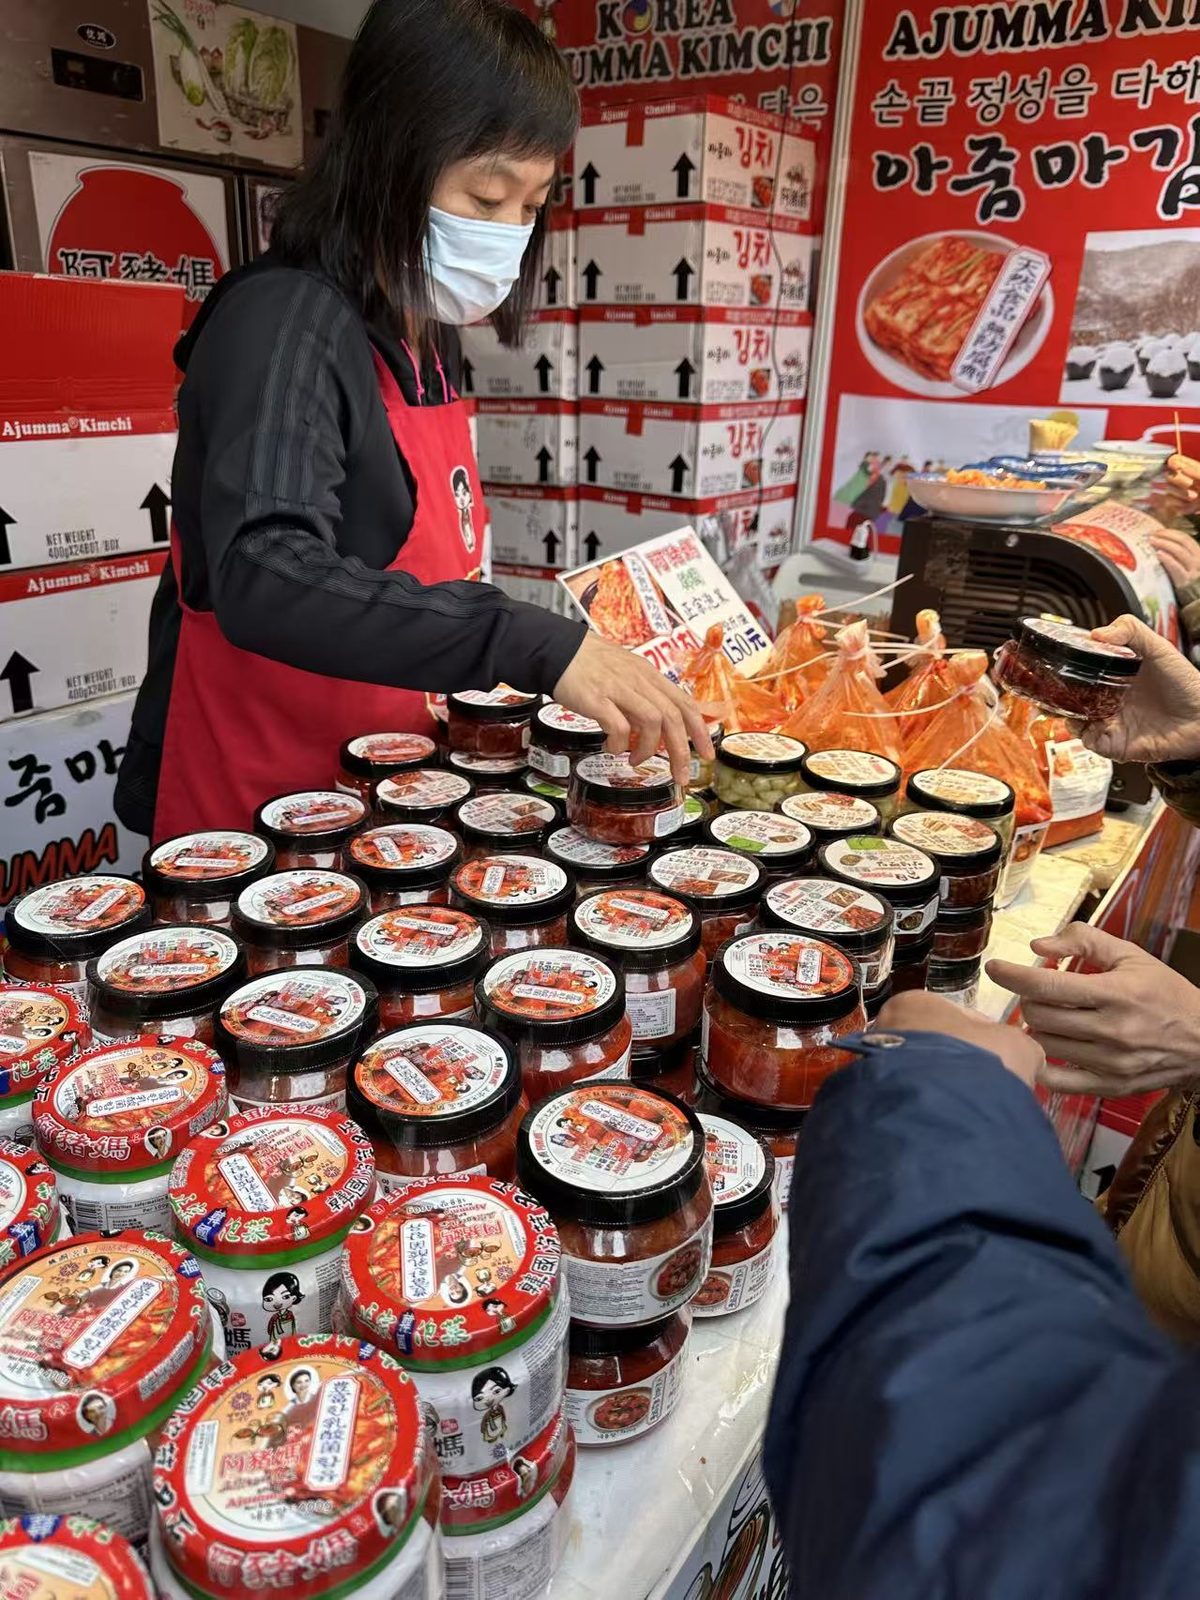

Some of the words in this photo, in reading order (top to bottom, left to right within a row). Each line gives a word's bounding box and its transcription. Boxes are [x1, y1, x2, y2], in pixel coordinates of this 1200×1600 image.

[598, 0, 734, 40] KOREA
[885, 0, 1107, 56] AJUMMA
[680, 20, 831, 75] KIMCHI
[874, 81, 952, 124] 손끝
[969, 69, 1095, 122] 정성을
[79, 416, 132, 432] Kimchi
[46, 533, 62, 547] NET
[64, 528, 96, 543] WEIGHT
[99, 560, 149, 579] Kimchi
[66, 675, 82, 689] NET
[84, 667, 114, 685] WEIGHT
[12, 1047, 58, 1083] 泡菜
[36, 1112, 131, 1161] 阿豬媽
[218, 1216, 273, 1243] 泡菜
[414, 1314, 471, 1347] 泡菜
[433, 1434, 465, 1457] 媽
